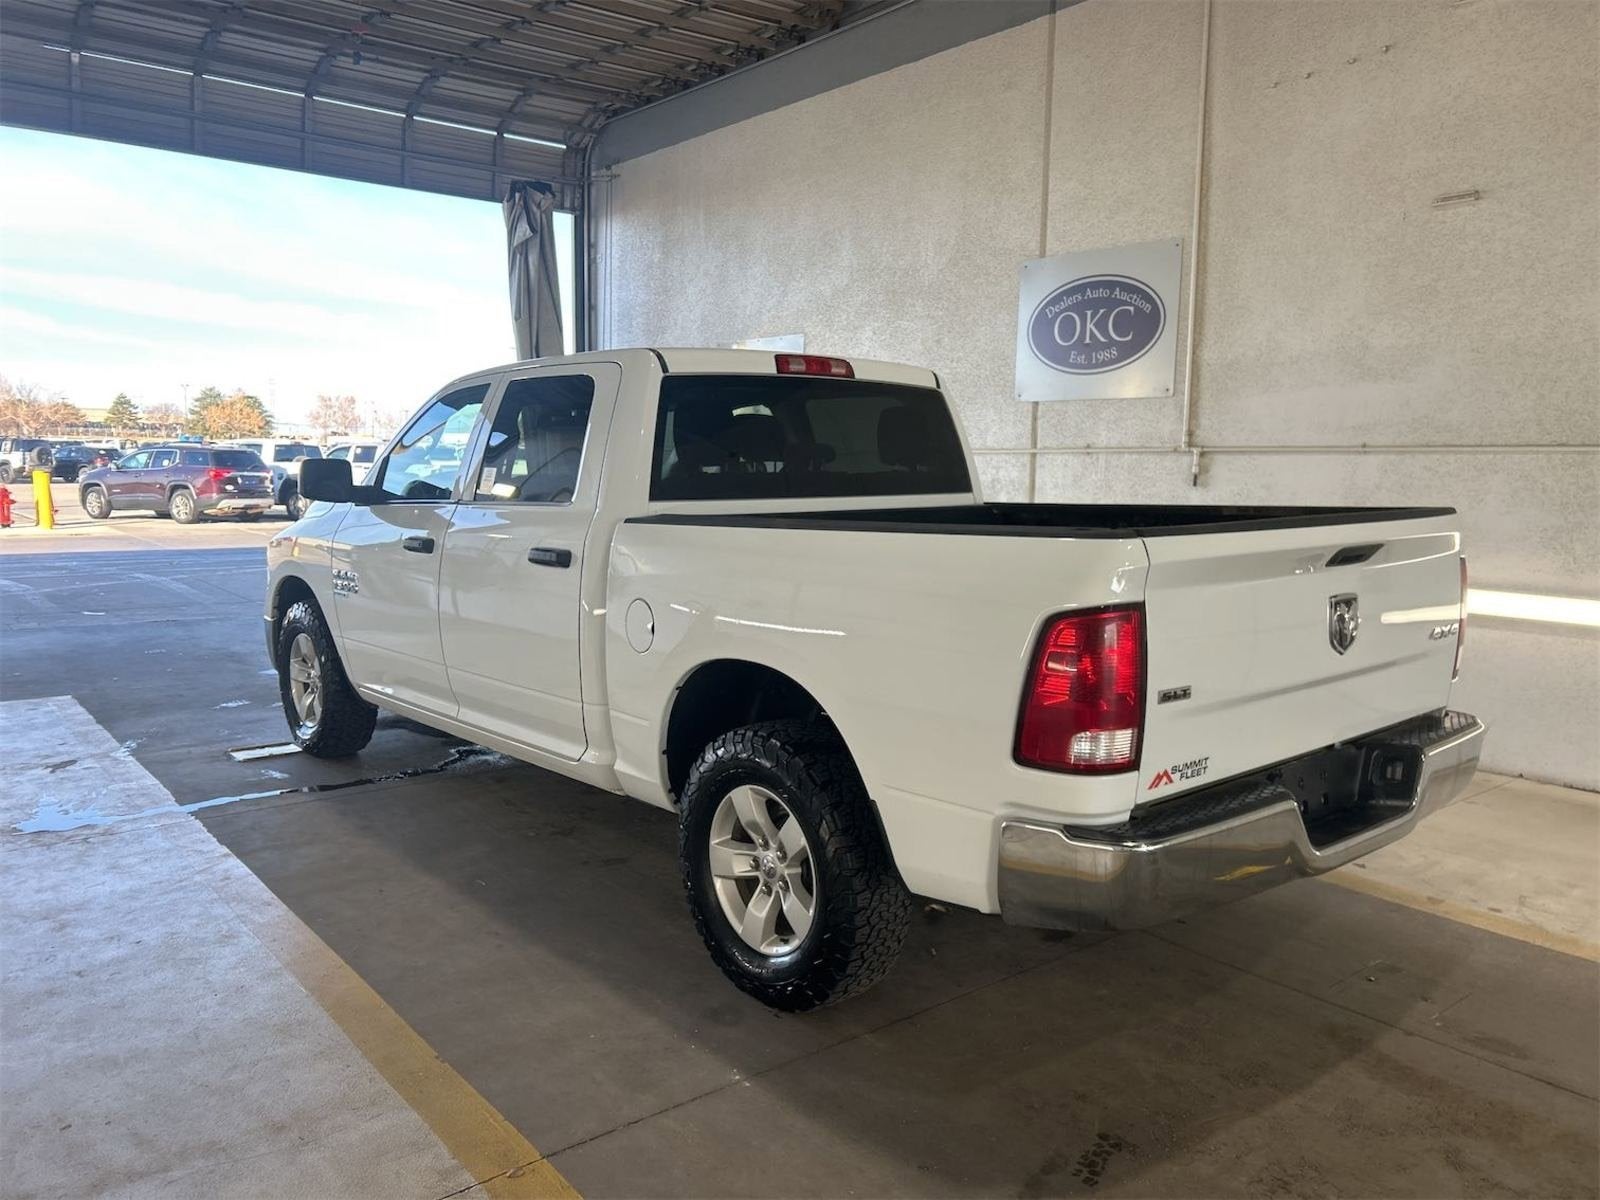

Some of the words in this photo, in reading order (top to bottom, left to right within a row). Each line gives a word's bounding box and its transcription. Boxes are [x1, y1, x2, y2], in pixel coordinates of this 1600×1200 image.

[1045, 292, 1082, 318] Dealers
[1084, 287, 1110, 300] Auto
[1112, 287, 1152, 314] Auction
[1054, 305, 1134, 346] OKC
[1069, 350, 1088, 364] Est.
[1091, 346, 1118, 364] 1988
[1159, 686, 1191, 703] SLT
[1171, 757, 1210, 775] SUMMIT
[1179, 766, 1208, 780] FLEET
